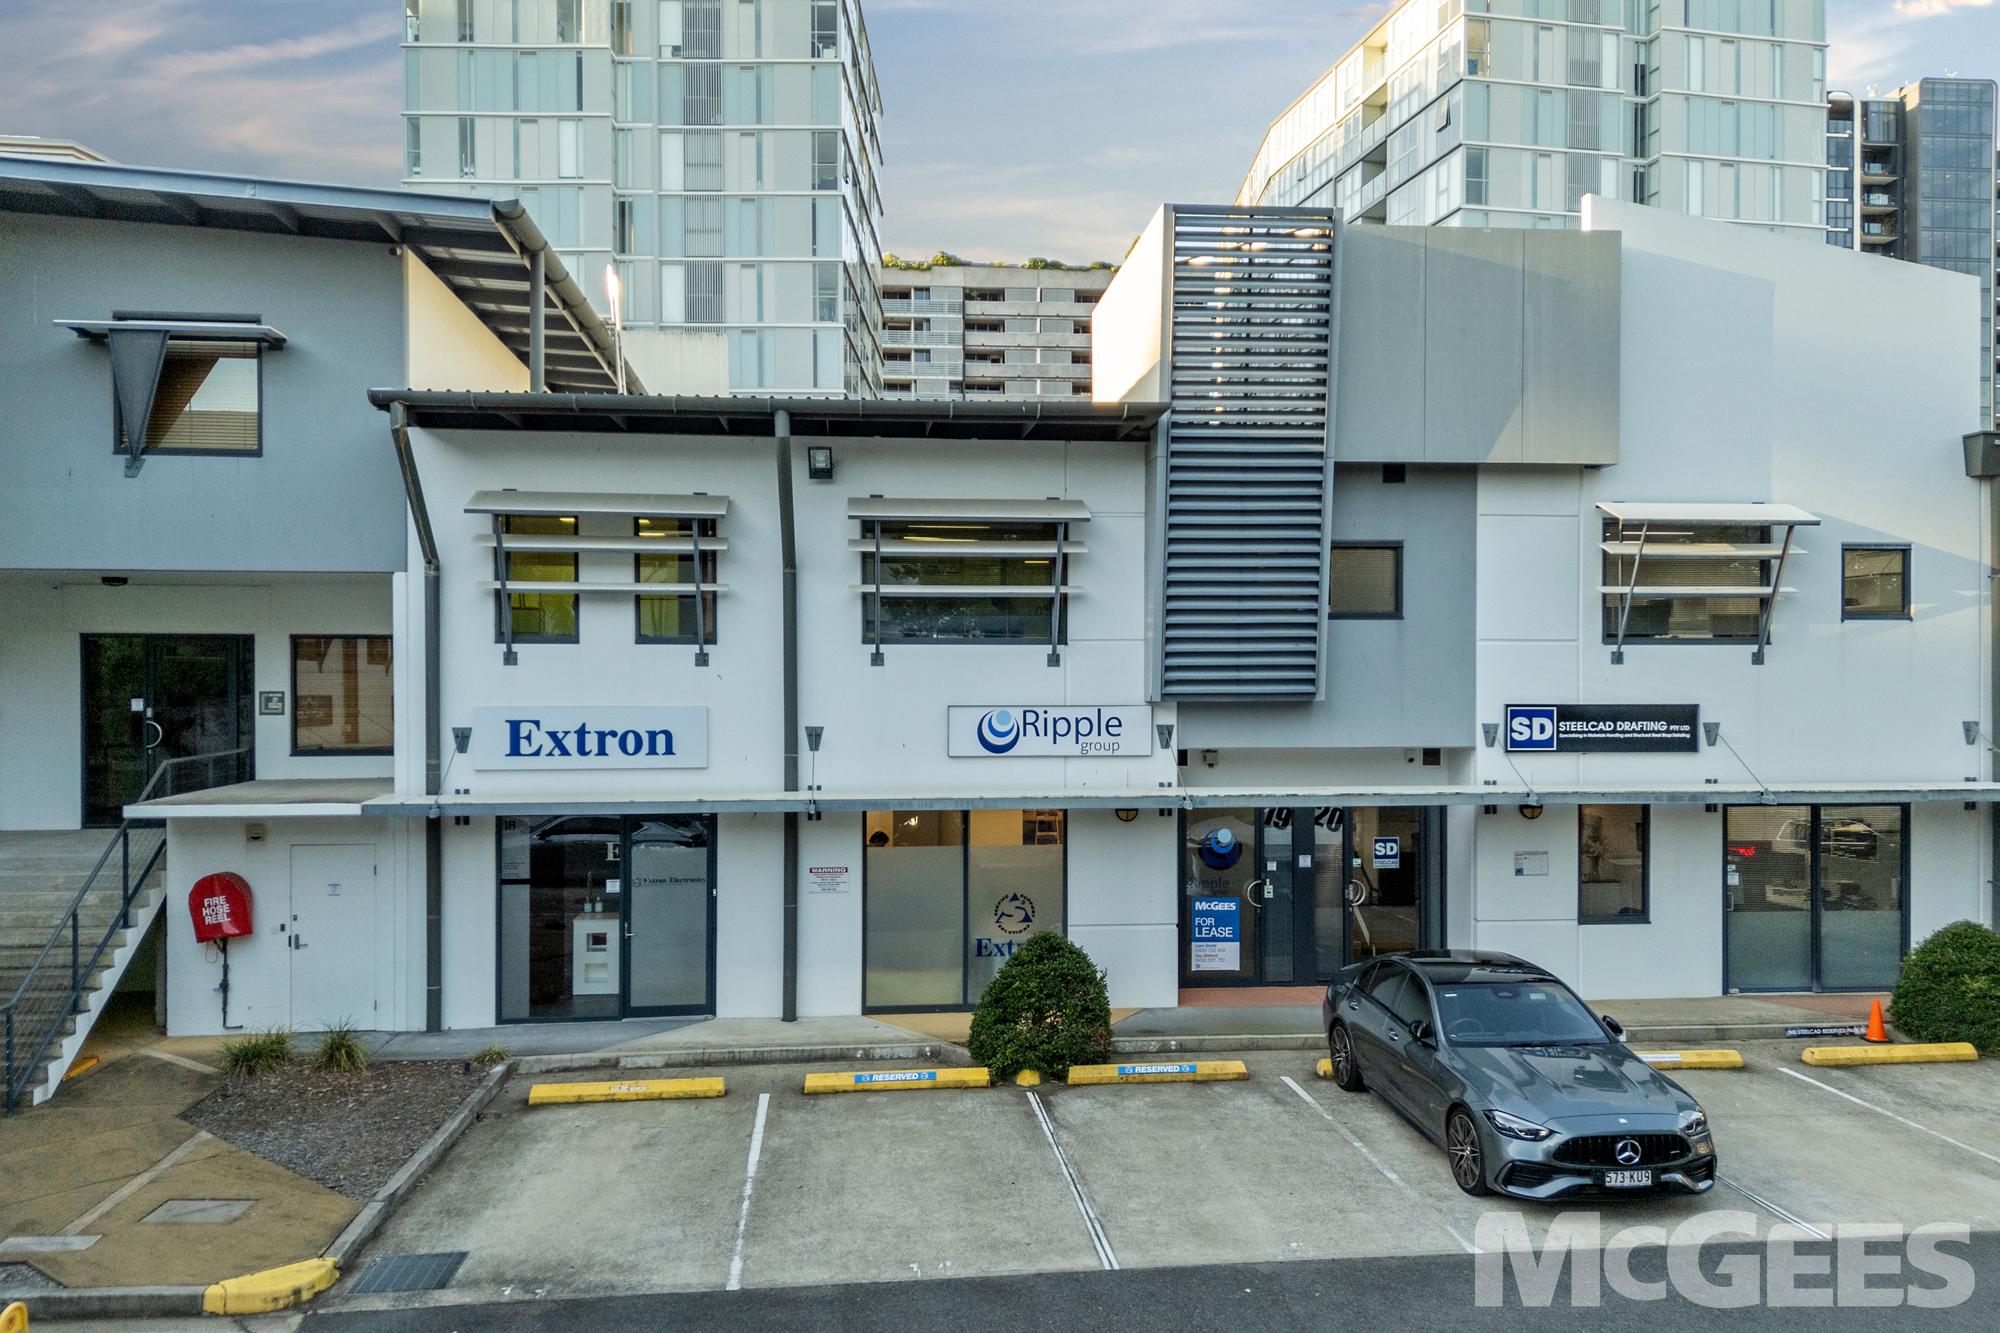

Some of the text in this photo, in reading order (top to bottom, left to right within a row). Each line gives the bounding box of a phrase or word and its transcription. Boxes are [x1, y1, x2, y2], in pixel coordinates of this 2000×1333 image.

[1022, 708, 1123, 745] Ripple
[1511, 716, 1553, 741] SD
[1558, 721, 1614, 731] STEELCAD
[1616, 721, 1668, 731] DRAFTING
[505, 719, 676, 757] Extron
[1080, 741, 1120, 755] group
[1264, 807, 1291, 830] 19
[1314, 807, 1343, 832] 20
[503, 821, 516, 831] 18
[1375, 842, 1398, 856] SD
[204, 896, 227, 907] FIRE
[202, 904, 231, 917] HOSE
[205, 913, 232, 925] REEL
[1195, 917, 1215, 926] FOR
[1195, 927, 1233, 938] LEASE
[1135, 1065, 1180, 1073] RESERVED
[872, 1073, 919, 1082] RESERVED
